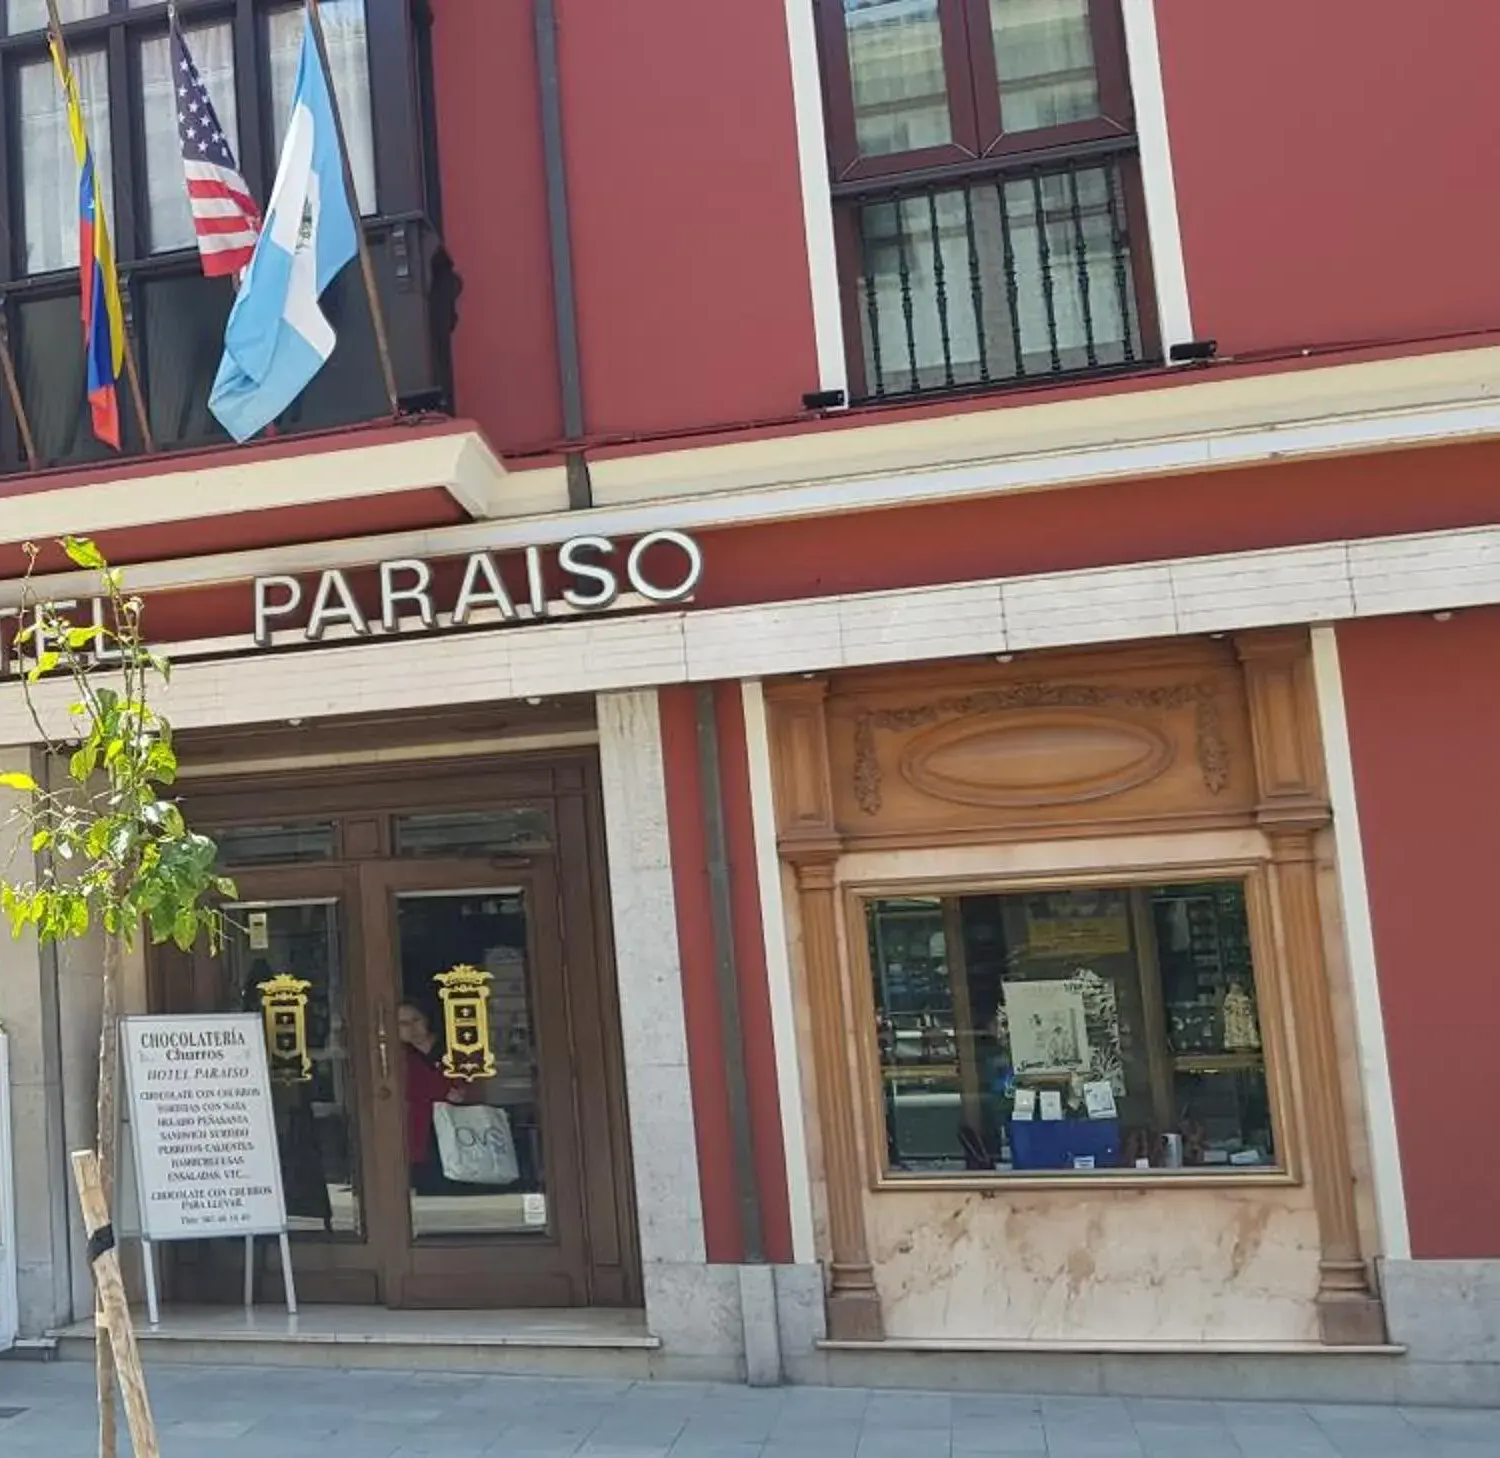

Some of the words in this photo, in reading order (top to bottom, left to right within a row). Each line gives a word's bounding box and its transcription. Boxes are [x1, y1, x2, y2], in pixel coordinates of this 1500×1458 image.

[253, 529, 703, 648] PARAISO
[140, 1027, 246, 1049] CHOCOLATERÍA
[165, 1048, 225, 1062] Churros
[147, 1067, 190, 1081] HOTEL
